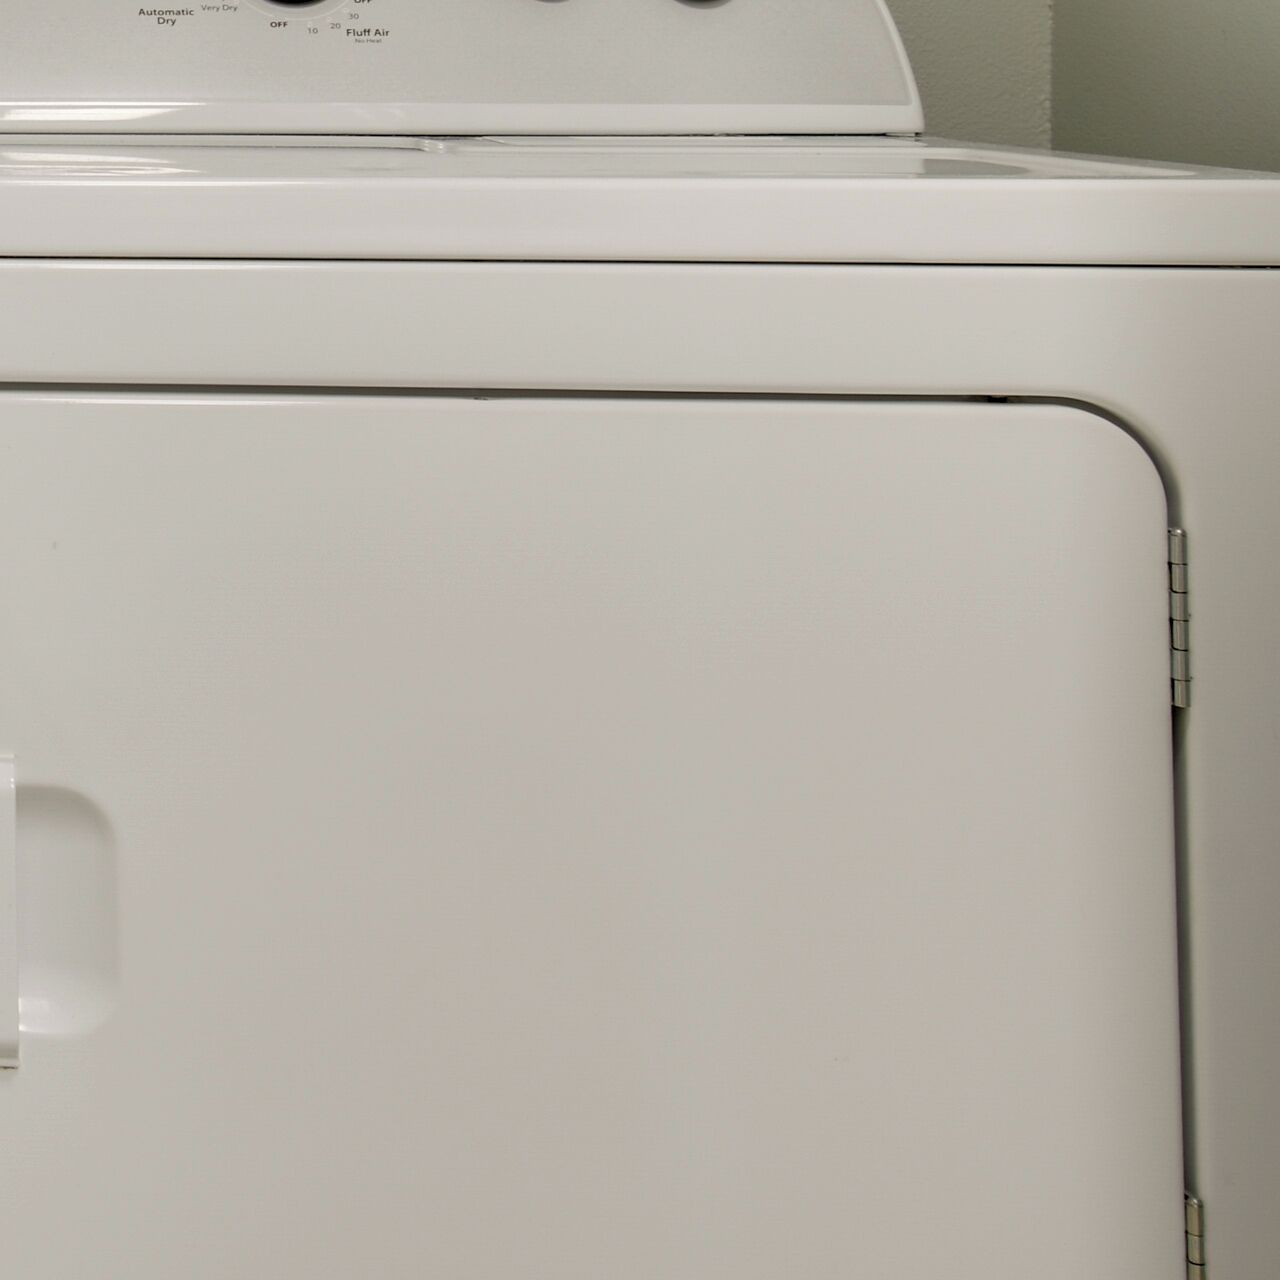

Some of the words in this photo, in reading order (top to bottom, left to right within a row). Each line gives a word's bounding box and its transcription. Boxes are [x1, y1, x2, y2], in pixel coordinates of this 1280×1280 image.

[138, 7, 195, 17] Automatic
[201, 4, 221, 13] Very
[222, 4, 238, 12] Dry
[157, 16, 177, 26] Dry
[269, 20, 289, 28] OFF
[330, 22, 342, 30] 20
[308, 27, 319, 35] 10
[346, 28, 371, 37] Fluff
[373, 28, 390, 37] Air
